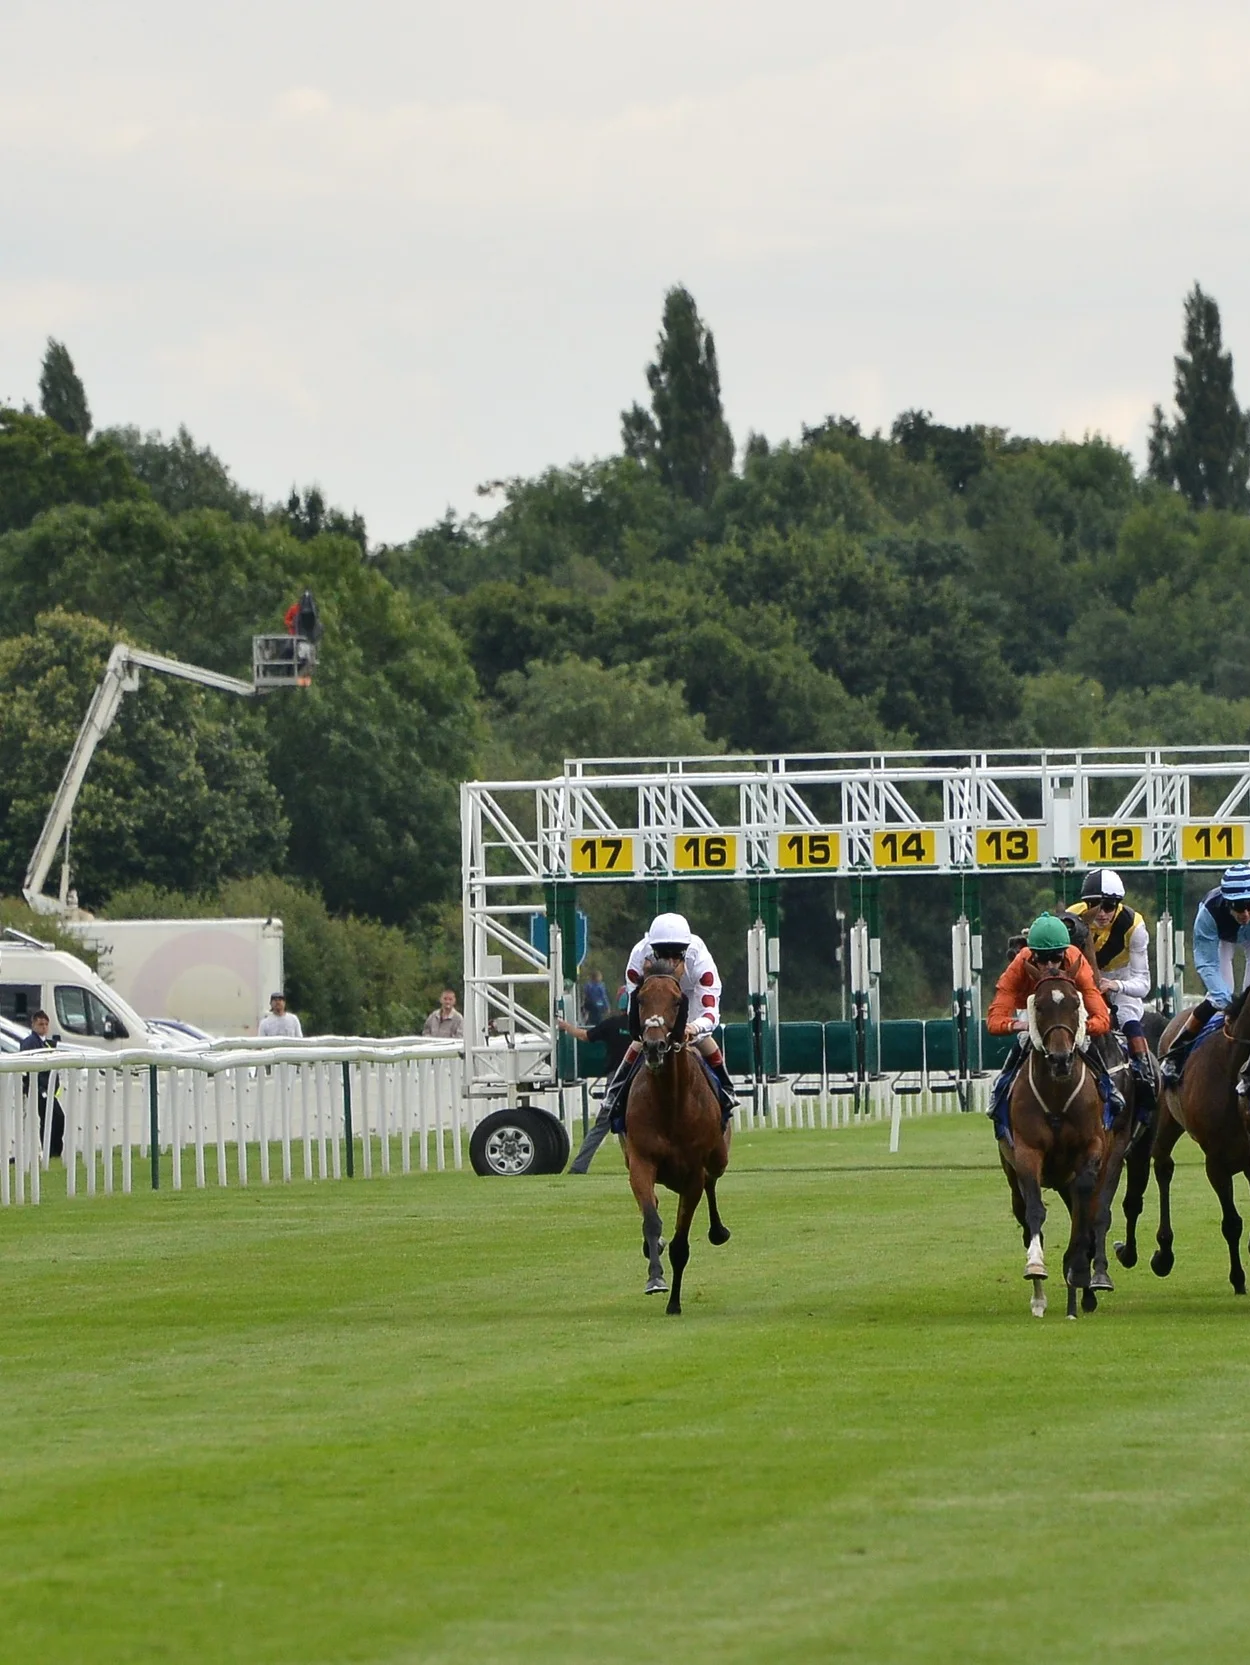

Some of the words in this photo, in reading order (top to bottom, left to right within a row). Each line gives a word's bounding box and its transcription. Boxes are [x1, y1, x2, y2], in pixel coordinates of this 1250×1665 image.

[580, 839, 623, 869] 17
[683, 837, 727, 867] 16
[787, 834, 831, 865] 15
[881, 832, 926, 863] 14
[985, 830, 1029, 861] 13
[1090, 828, 1134, 859] 12
[1194, 827, 1233, 858] 11
